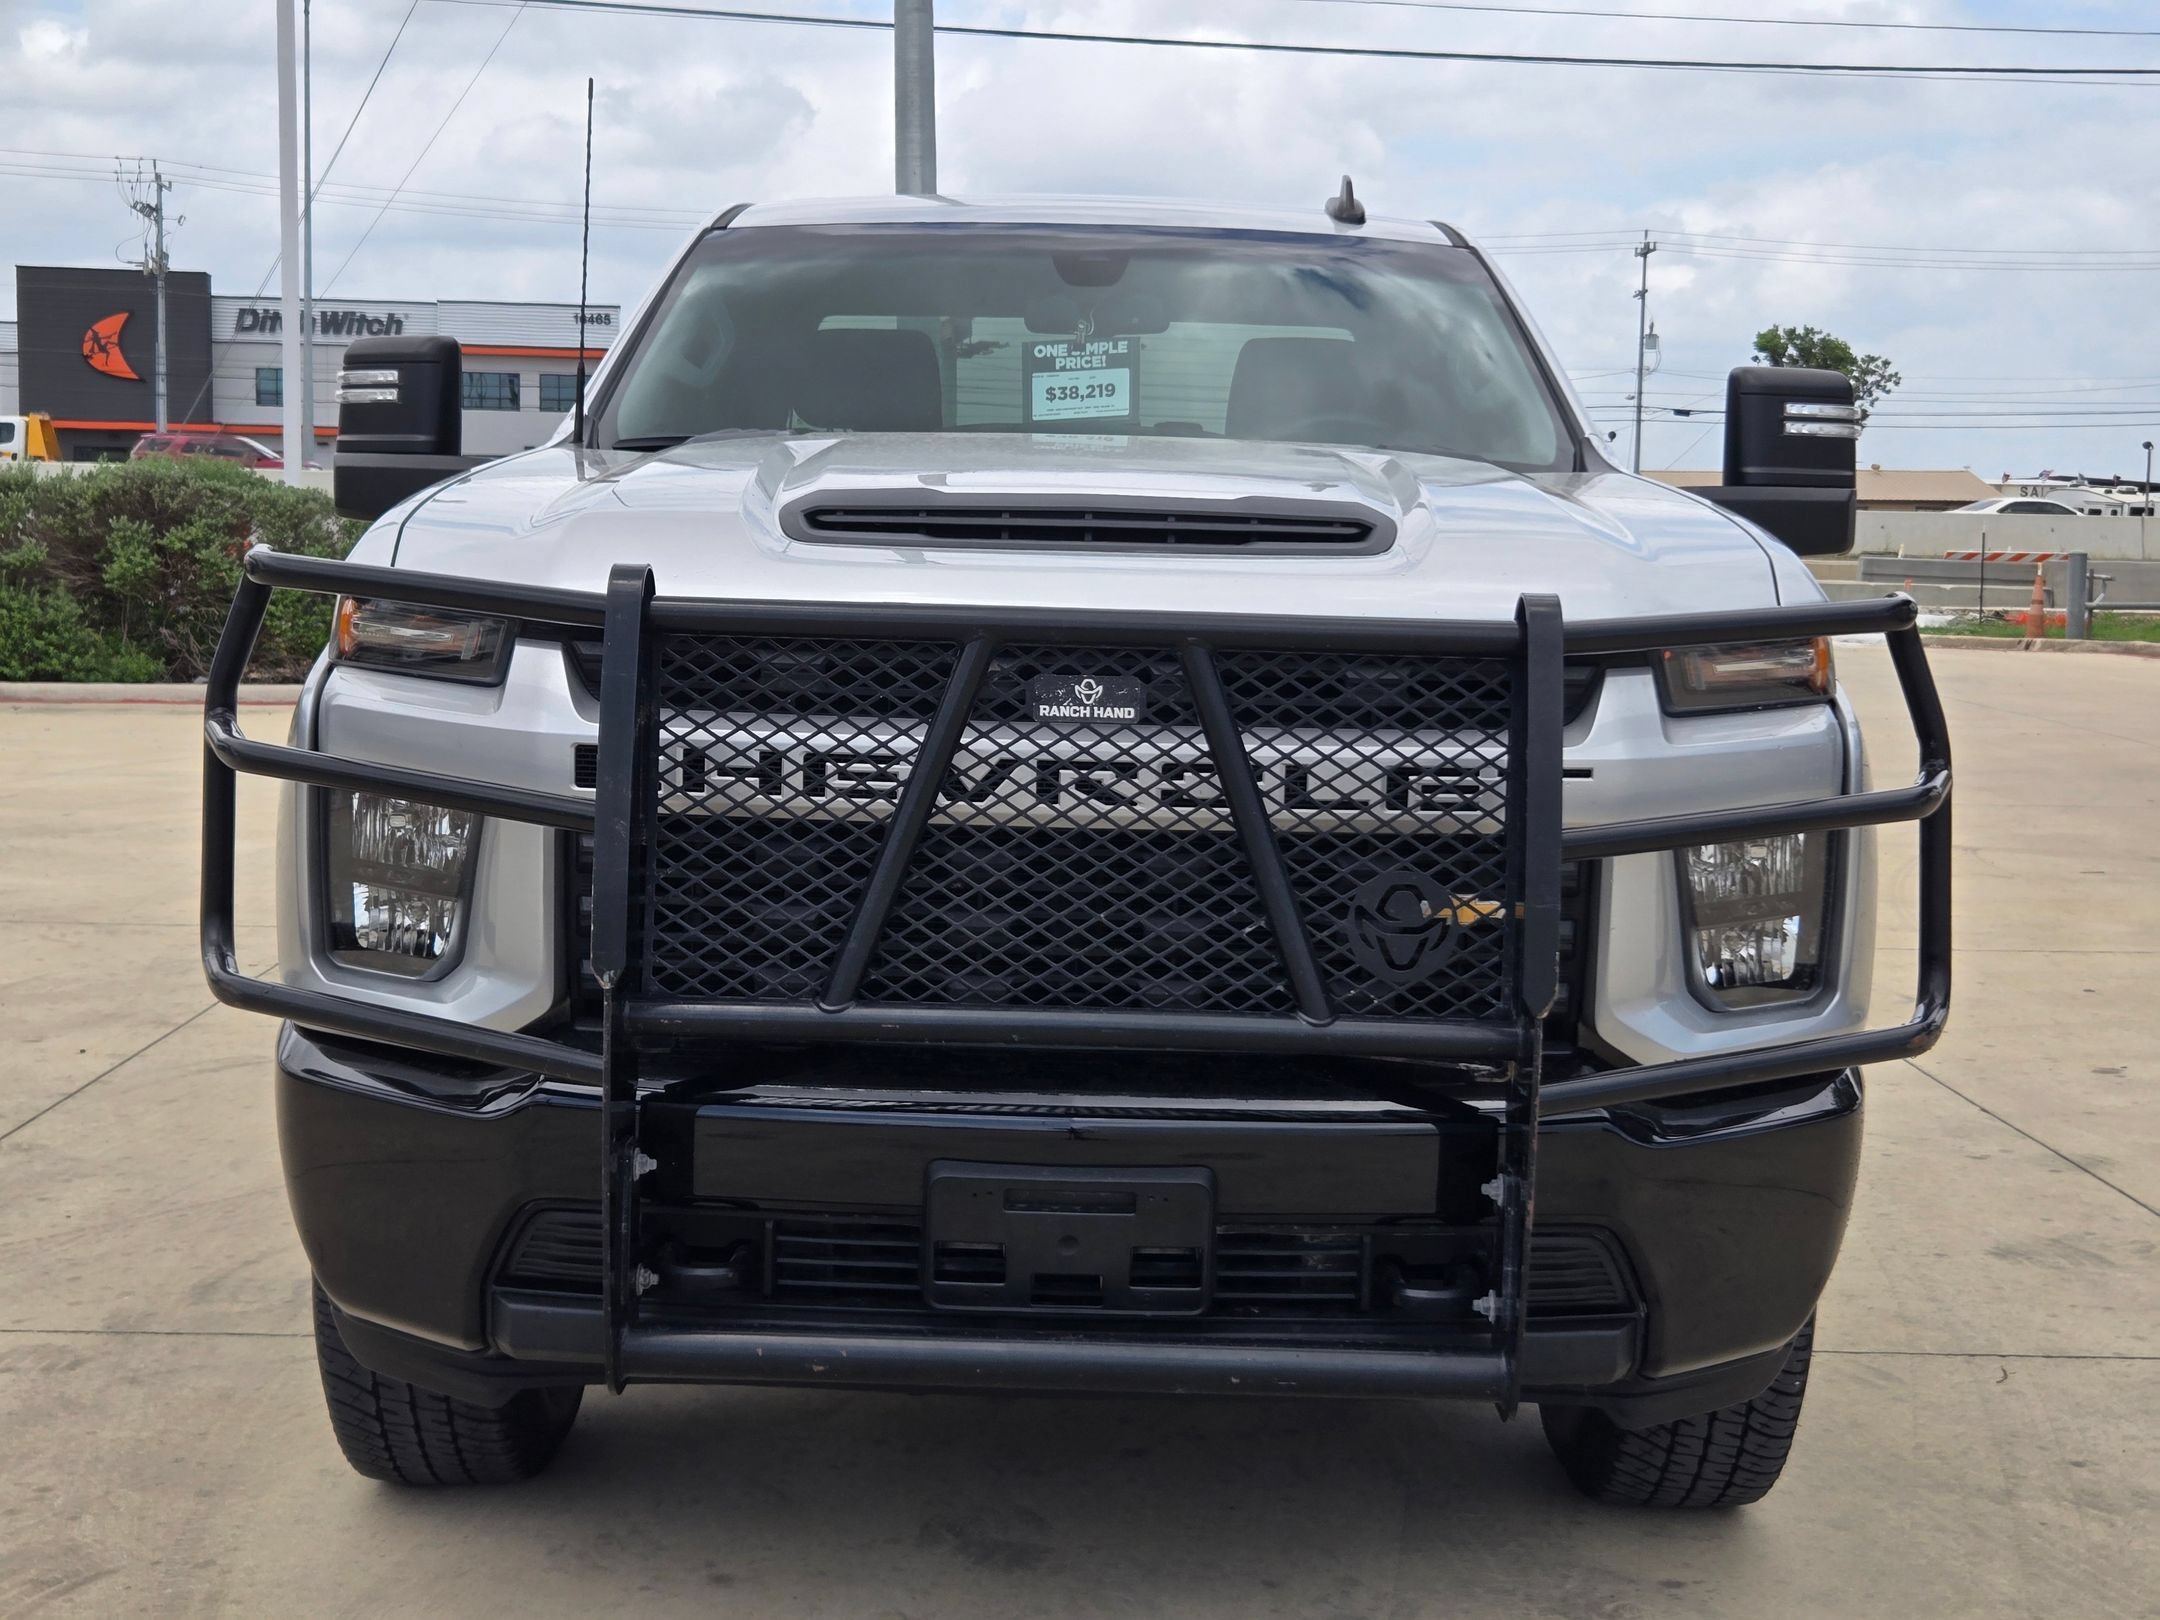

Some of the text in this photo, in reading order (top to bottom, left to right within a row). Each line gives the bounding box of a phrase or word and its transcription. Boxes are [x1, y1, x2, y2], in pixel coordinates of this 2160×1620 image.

[234, 308, 403, 336] Dith Witch
[1033, 343, 1068, 358] ONE
[1055, 355, 1107, 370] PRICE!
[1045, 383, 1116, 403] $38,219
[1039, 705, 1135, 719] RANCH HAND
[575, 744, 1592, 813] HEVROLE
